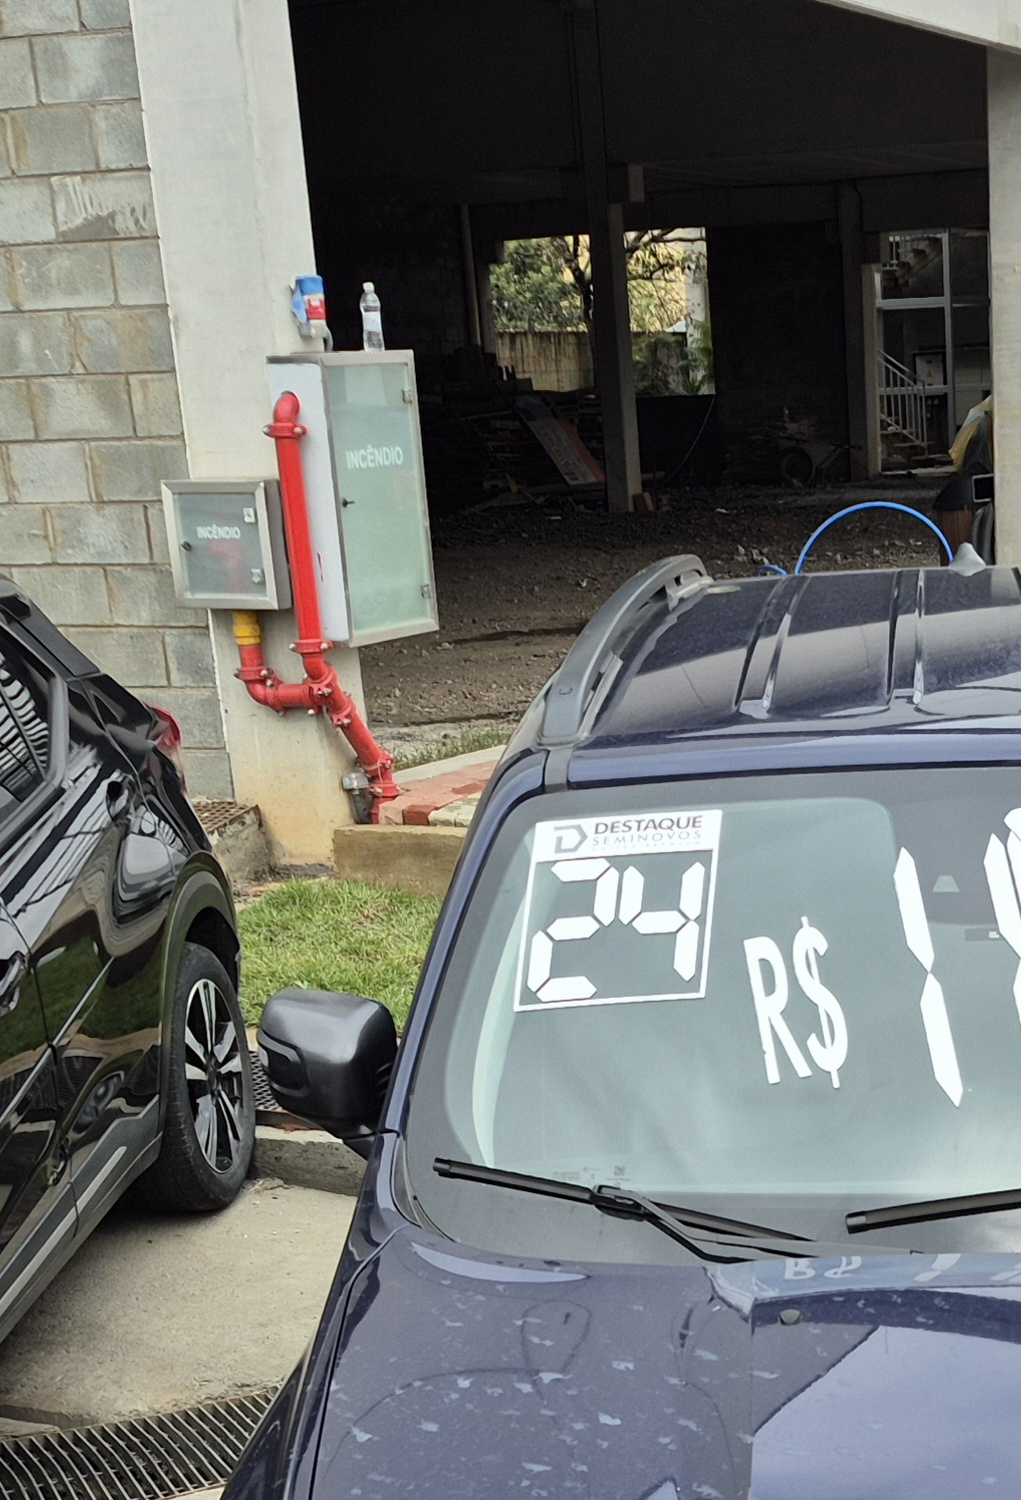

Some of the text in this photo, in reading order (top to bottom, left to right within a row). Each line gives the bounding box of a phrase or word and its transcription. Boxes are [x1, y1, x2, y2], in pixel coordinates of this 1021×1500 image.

[345, 444, 404, 470] INCÊNDIO
[594, 815, 703, 835] DESTAQUE
[592, 830, 702, 847] SEMINOVOS
[527, 858, 705, 1002] 24
[743, 915, 848, 1089] R$
